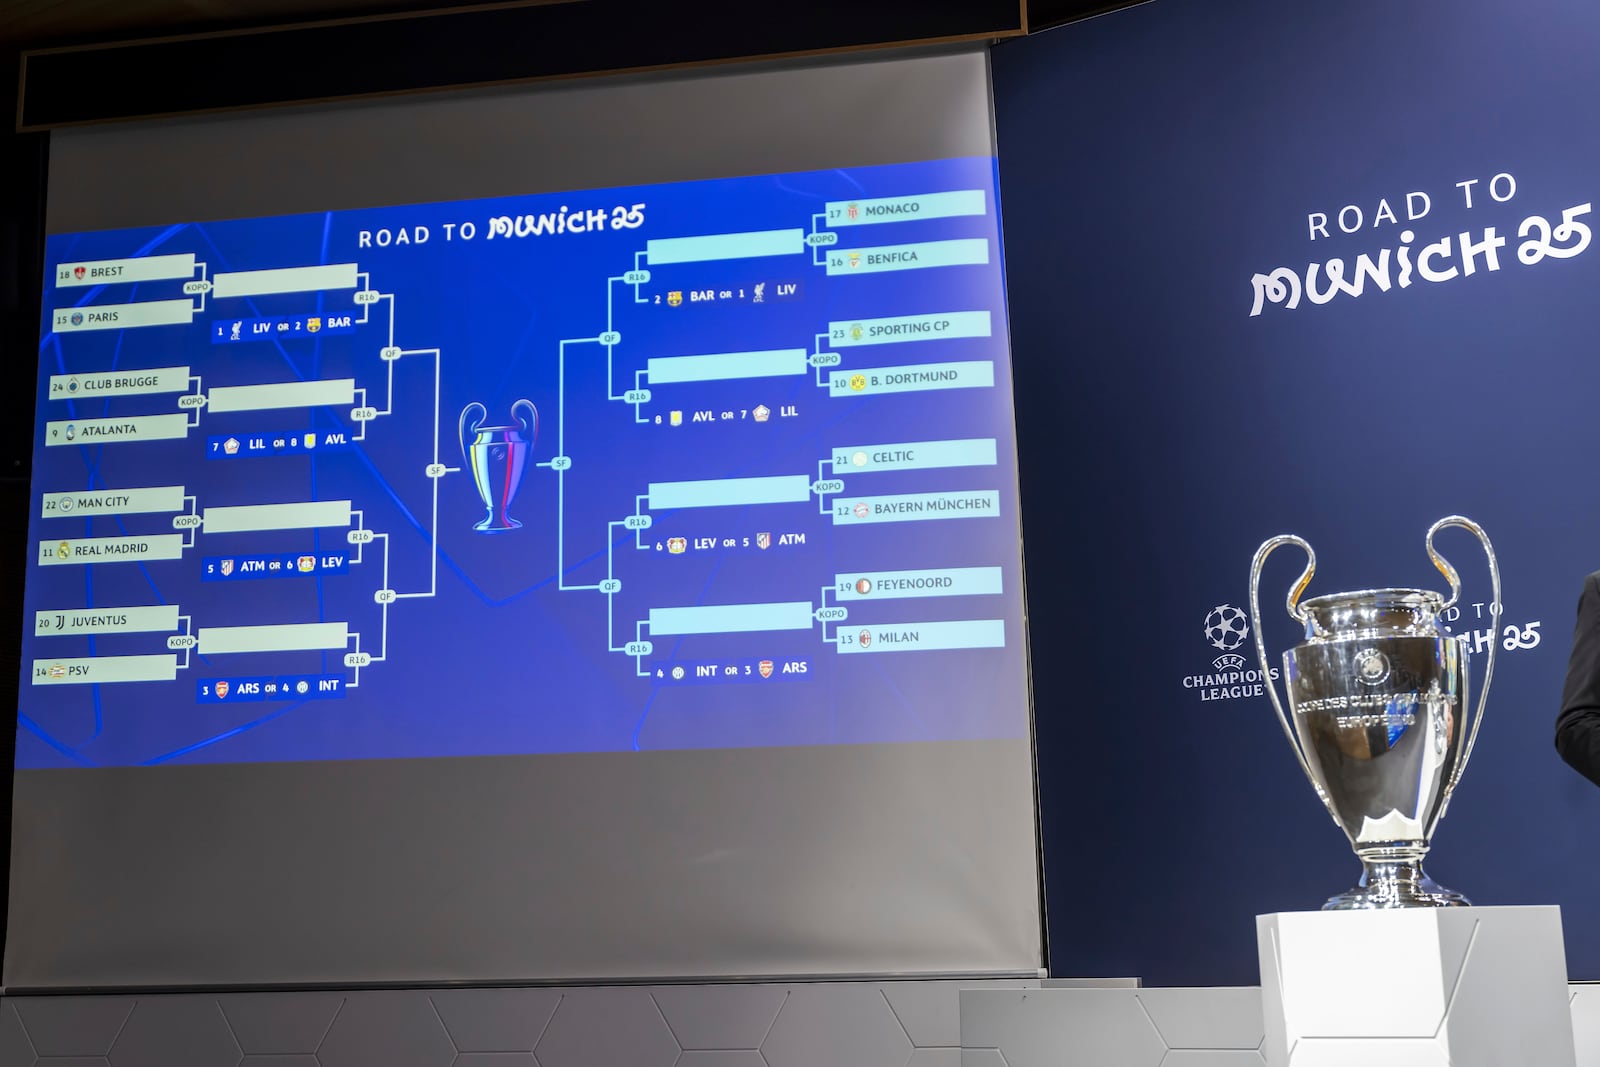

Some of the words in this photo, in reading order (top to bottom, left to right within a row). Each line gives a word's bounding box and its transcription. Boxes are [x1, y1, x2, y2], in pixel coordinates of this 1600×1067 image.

[829, 209, 841, 218] 17
[865, 202, 919, 216] MONACO
[1308, 191, 1431, 241] ROAD
[1456, 173, 1516, 209] TO
[359, 226, 429, 248] ROAD
[443, 222, 476, 241] TO
[611, 203, 646, 230] 25
[810, 235, 834, 243] KOPO
[1517, 202, 1592, 265] 25
[831, 257, 843, 267] 16
[867, 252, 918, 265] BENFICA
[60, 271, 70, 279] 18
[90, 266, 123, 277] BREST
[629, 273, 645, 282] R16
[186, 283, 208, 292] KOPO
[654, 295, 661, 304] 2
[690, 289, 714, 302] BAR
[720, 290, 732, 298] OR
[777, 284, 796, 296] LIV
[359, 293, 375, 301] R16
[57, 315, 67, 324] 15
[88, 312, 118, 323] PARIS
[253, 322, 270, 334] LIV
[277, 323, 289, 331] OR
[328, 317, 350, 328] BAR
[833, 329, 845, 338] 23
[869, 323, 931, 337] SPORTING
[933, 320, 950, 331] CP
[604, 334, 616, 343] QF
[385, 349, 396, 358] QF
[813, 356, 838, 364] KOPO
[53, 382, 63, 391] 24
[84, 379, 113, 391] CLUB
[115, 376, 159, 388] BRUGGE
[834, 379, 846, 388] 10
[871, 375, 882, 386] B.
[885, 370, 958, 385] DORTMUND
[181, 397, 203, 406] KOPO
[630, 392, 645, 401] R16
[356, 409, 372, 418] R16
[655, 415, 662, 424] 8
[692, 410, 715, 423] AVL
[721, 411, 734, 420] OR
[781, 405, 798, 418] LIL
[81, 424, 137, 436] ATALANTA
[249, 439, 265, 450] LIL
[273, 439, 285, 448] OR
[325, 433, 346, 445] AVL
[836, 456, 848, 465] 21
[873, 450, 914, 463] CELTIC
[816, 482, 841, 491] KOPO
[45, 501, 56, 509] 22
[77, 497, 102, 508] MAN
[105, 496, 130, 507] CITY
[837, 506, 850, 516] 12
[874, 500, 923, 514] BAYERN
[926, 498, 991, 511] MÜNCHEN
[176, 517, 198, 526] KOPO
[630, 517, 646, 526] R16
[352, 533, 368, 541] R16
[656, 542, 663, 551] 6
[694, 538, 717, 550] LEV
[723, 538, 735, 547] OR
[779, 533, 805, 545] ATM
[43, 549, 53, 557] 11
[75, 544, 102, 555] REAL
[105, 542, 148, 554] MADRID
[240, 560, 265, 572] ATM
[269, 561, 280, 570] OR
[322, 557, 343, 568] LEV
[604, 582, 617, 591] QF
[840, 582, 852, 592] 19
[877, 576, 952, 590] FEYENOORD
[379, 592, 392, 601] QF
[819, 609, 844, 619] KOPO
[39, 619, 49, 628] 20
[71, 615, 127, 627] JUVENTUS
[170, 638, 193, 647] KOPO
[841, 635, 853, 644] 13
[879, 631, 919, 644] MILAN
[1503, 621, 1541, 651] 25
[630, 644, 647, 653] R16
[349, 655, 365, 664] R16
[1214, 657, 1243, 669] UEFA
[36, 668, 46, 677] 14
[68, 665, 90, 676] PSV
[657, 669, 664, 678] 4
[696, 665, 717, 677] INT
[725, 666, 737, 674] OR
[782, 661, 807, 674] ARS
[237, 682, 259, 694] ARS
[265, 683, 276, 692] OR
[282, 683, 289, 693] 4
[319, 679, 339, 691] INT
[1201, 684, 1264, 701] LEAGUE
